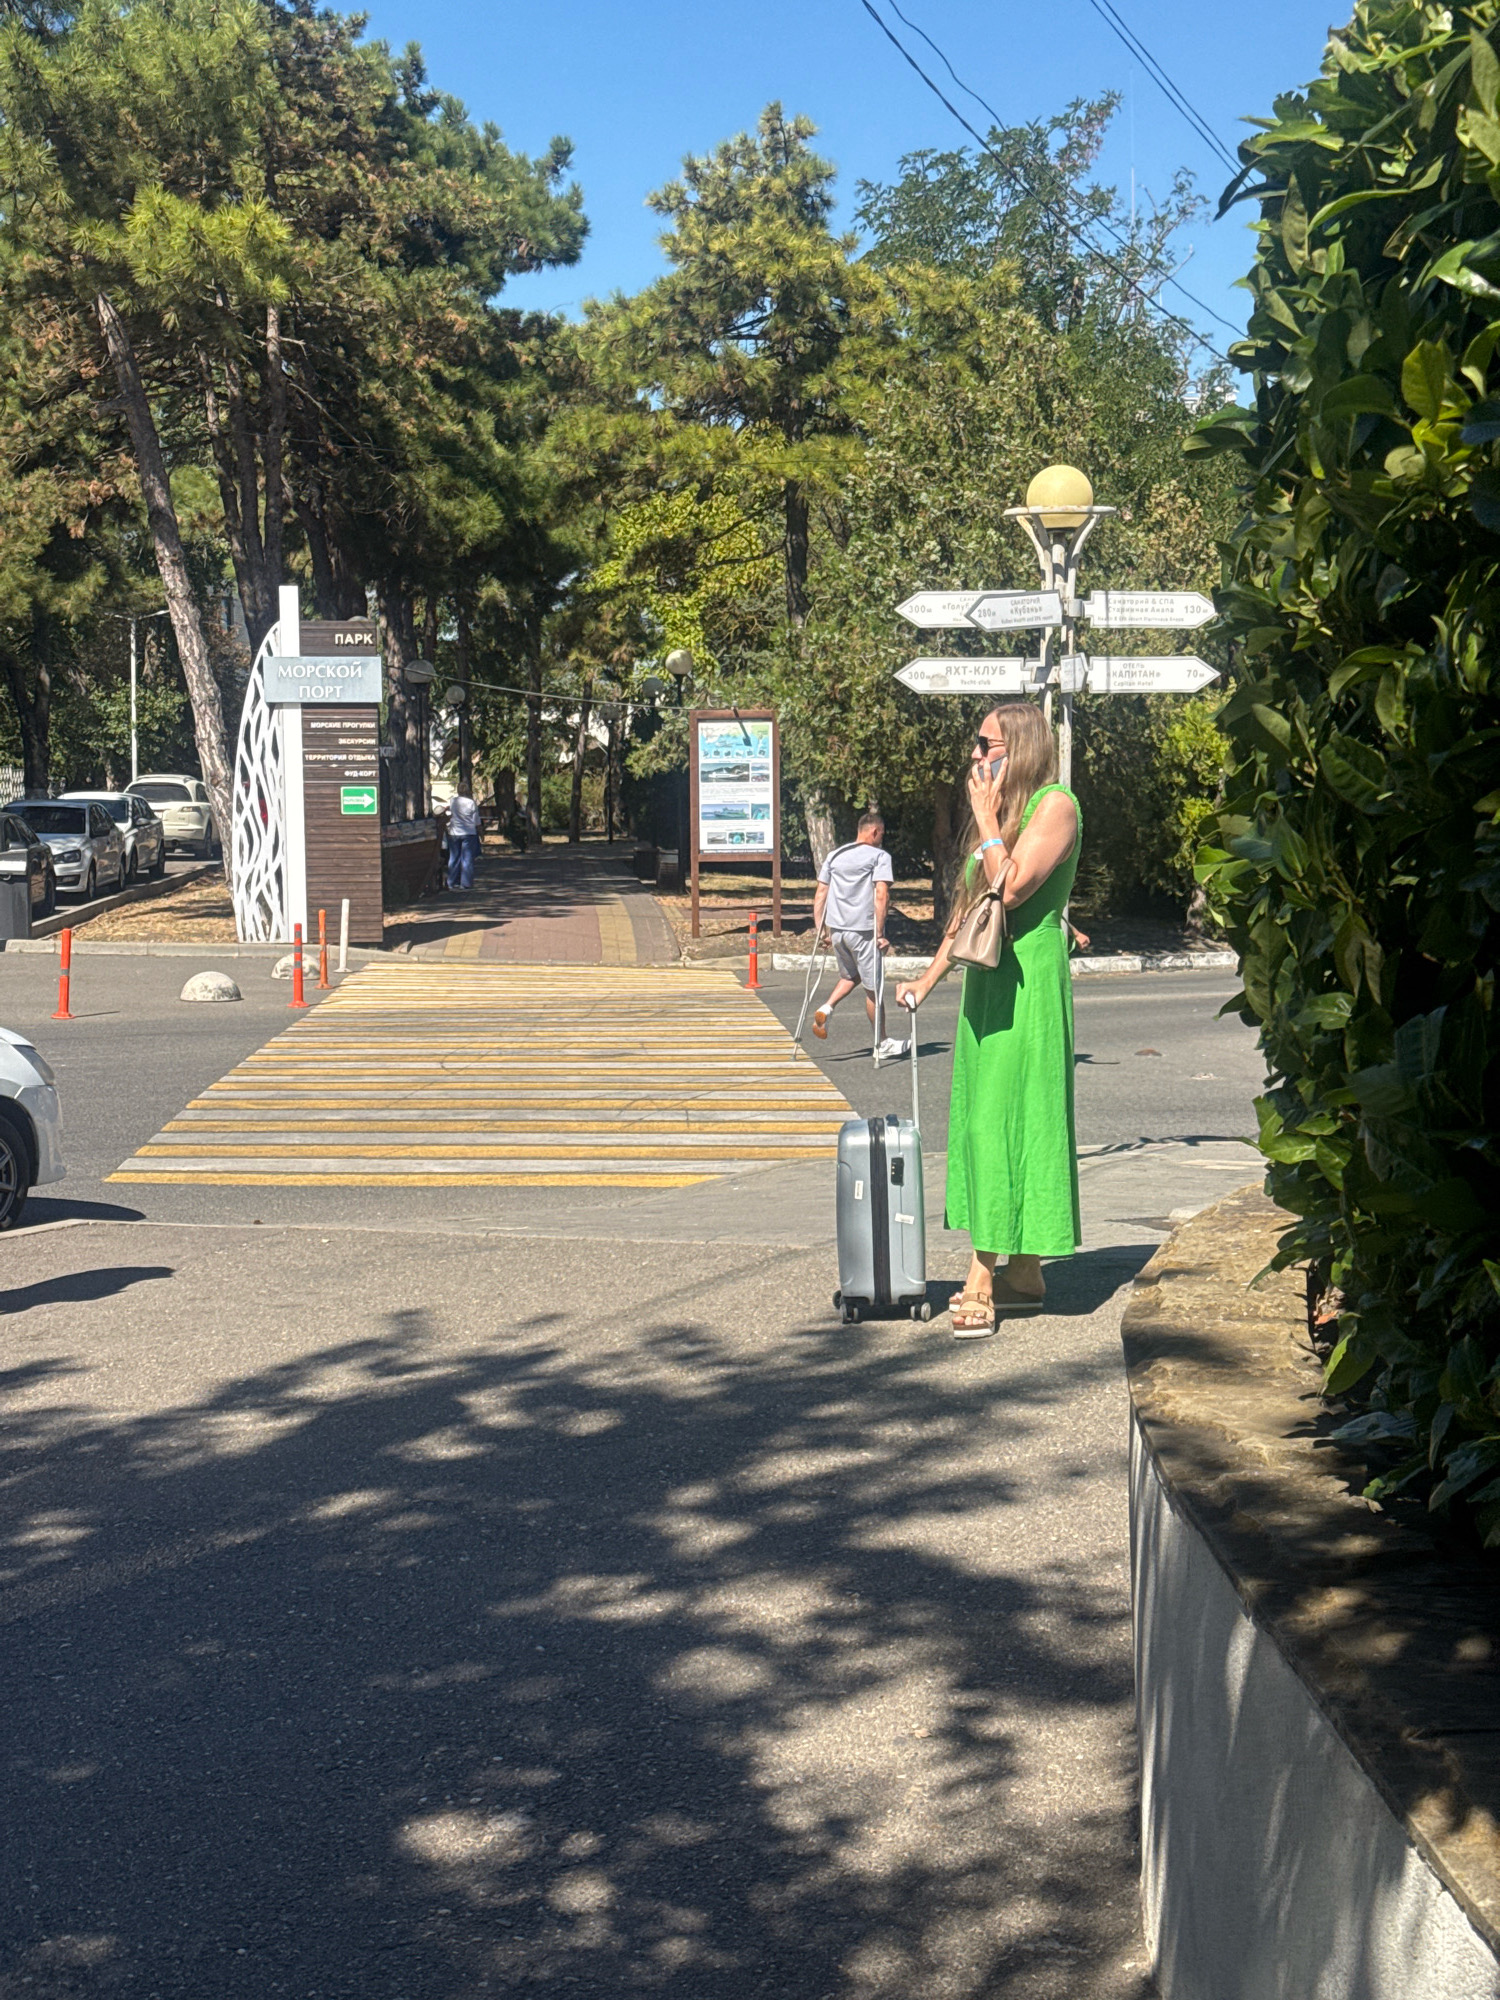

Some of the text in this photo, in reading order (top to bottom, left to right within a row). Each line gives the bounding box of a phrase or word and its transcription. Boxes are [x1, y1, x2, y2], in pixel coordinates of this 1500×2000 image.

[334, 633, 374, 645] ПАРК
[278, 661, 362, 678] МОРСКОЙ
[945, 665, 1007, 676] ЯХТ-КЛУБ
[299, 685, 344, 698] ПОРТ
[310, 721, 376, 729] МОРСКИЕ ПРОГУЛКИ
[338, 737, 376, 745] ЭКСКУРСИИ
[348, 754, 377, 762] ОТДЫХА
[344, 770, 377, 778] ФУД-КОРТ
